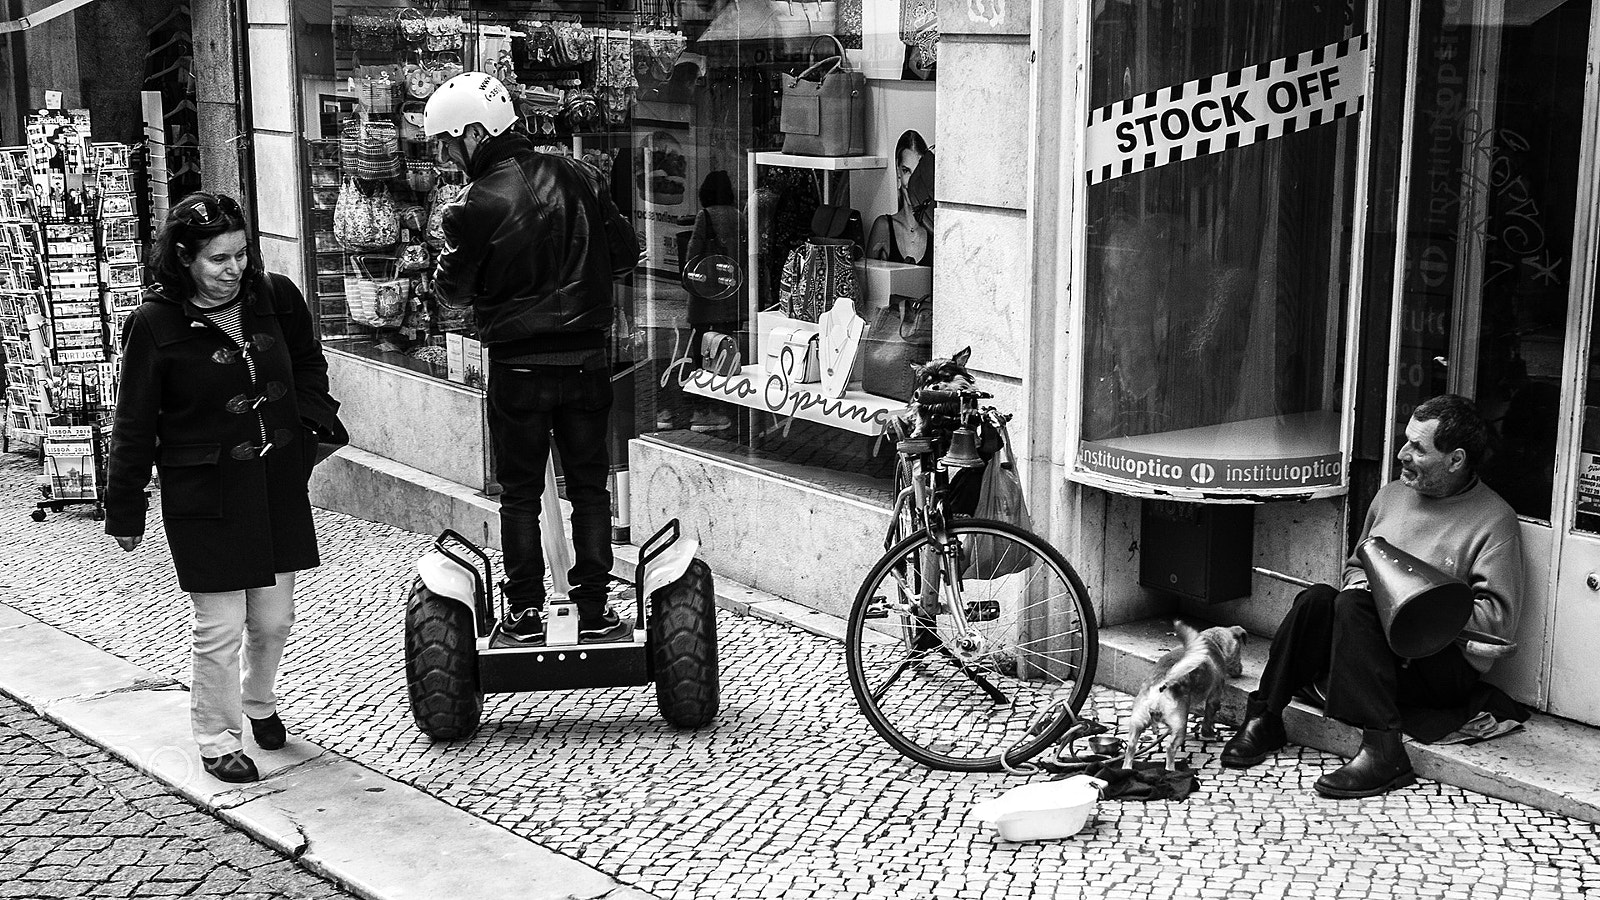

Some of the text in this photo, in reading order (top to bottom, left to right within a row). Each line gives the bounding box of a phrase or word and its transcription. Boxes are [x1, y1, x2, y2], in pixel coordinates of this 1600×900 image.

[1115, 65, 1341, 153] STOCK OFF
[660, 327, 895, 457] Hello Spring
[1226, 460, 1341, 483] institutoptico
